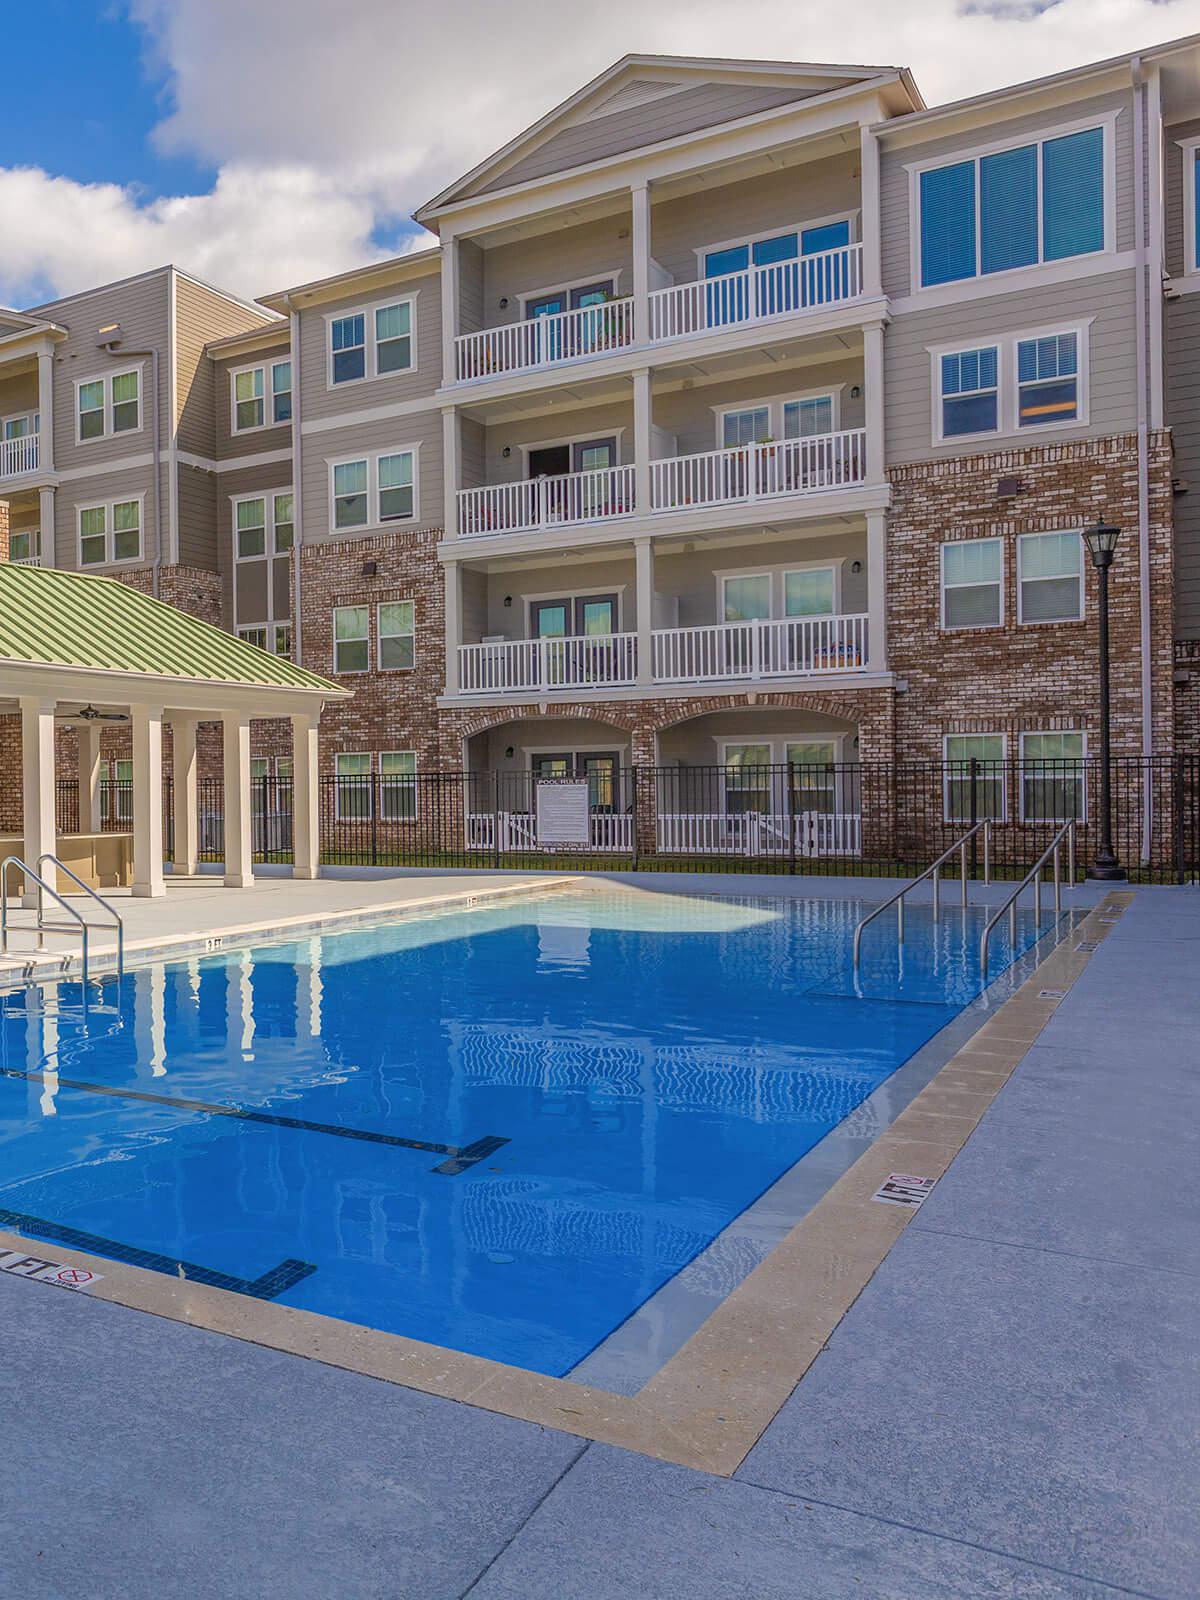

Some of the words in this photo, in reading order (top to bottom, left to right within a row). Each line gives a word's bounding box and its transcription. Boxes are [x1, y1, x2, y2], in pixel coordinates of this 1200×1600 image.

[881, 1182, 929, 1198] FT
[875, 1193, 921, 1204] 4
[5, 1257, 62, 1275] FT
